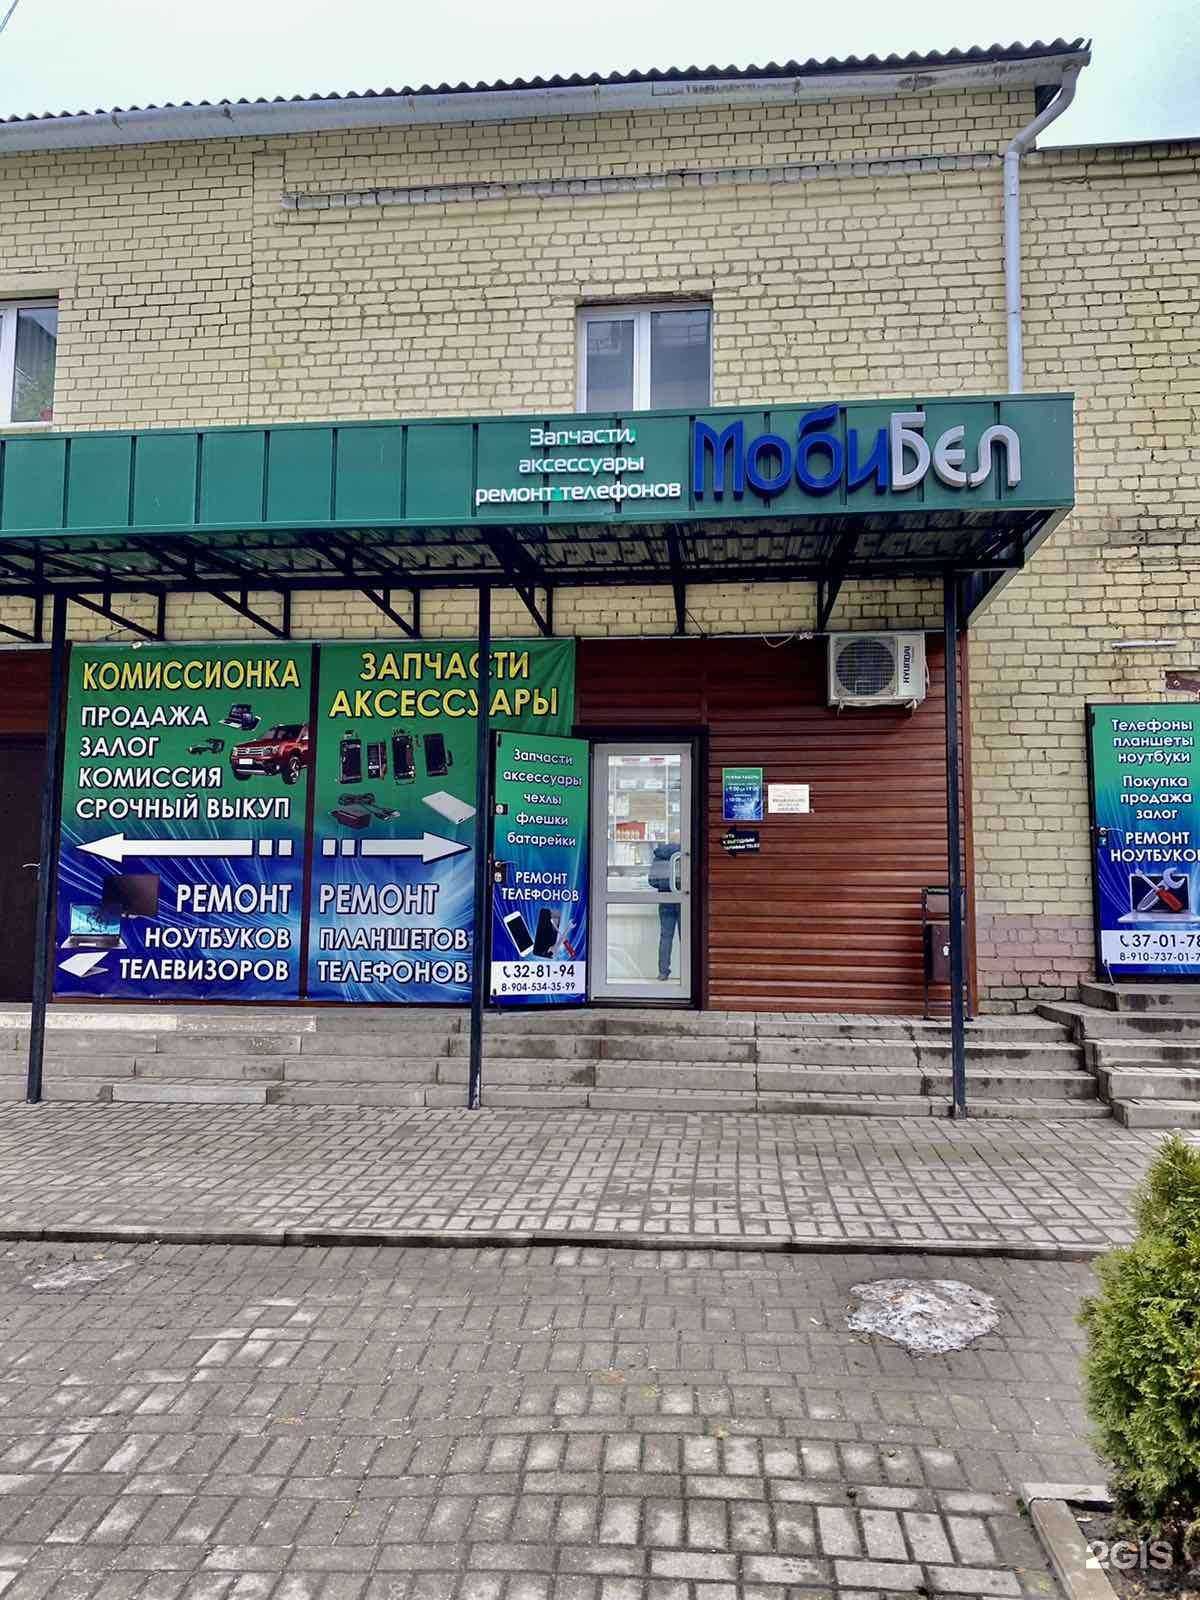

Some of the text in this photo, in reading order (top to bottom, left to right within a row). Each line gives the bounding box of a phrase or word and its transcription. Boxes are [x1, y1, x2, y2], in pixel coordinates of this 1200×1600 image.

[692, 403, 1021, 500] МобиБел
[519, 456, 644, 475] аксессуары
[475, 481, 681, 506] ремонт телефонов
[359, 651, 529, 681] ЗАПЧАСТИ
[903, 645, 911, 684] HYUNDAI
[82, 659, 301, 690] КОМИССИОНКА
[328, 687, 558, 718] АКСЕССУАРЫ
[81, 705, 209, 729] ПРОДАЖА
[1112, 719, 1193, 733] Телефоны
[79, 736, 159, 758] ЗАЛОГ
[1113, 736, 1193, 747] планшеты
[513, 748, 573, 765] Запчасти
[1118, 750, 1191, 765] ноутбуки
[78, 767, 222, 788] КОМИССИЯ
[503, 771, 582, 787] аксессуары
[1123, 775, 1189, 790] Покупка
[76, 793, 290, 819] СРОЧНЫЙ ВЫКУП
[523, 793, 562, 805] чехлы
[1120, 793, 1192, 805] продажа
[516, 812, 568, 825] флешки
[1136, 809, 1178, 819] залог
[507, 831, 576, 847] батарейки
[1125, 831, 1190, 845] РЕМОНТ
[1110, 848, 1200, 862] НОУТБУКО
[515, 871, 568, 885] РЕМОНТ
[176, 884, 292, 914] РЕМОНТ
[318, 884, 440, 914] РЕМОНТ
[502, 887, 579, 902] ТЕЛЕФОНОВ
[144, 927, 291, 949] НОУТБУКОВ
[319, 928, 468, 951] ПЛАНШЕТОВ
[119, 958, 290, 982] ТЕЛЕВИЗОРОВ
[318, 961, 469, 983] ТЕЛЕФОНОВ
[513, 964, 575, 978] 32-81-94
[501, 982, 576, 992] 8-904-534-35-99
